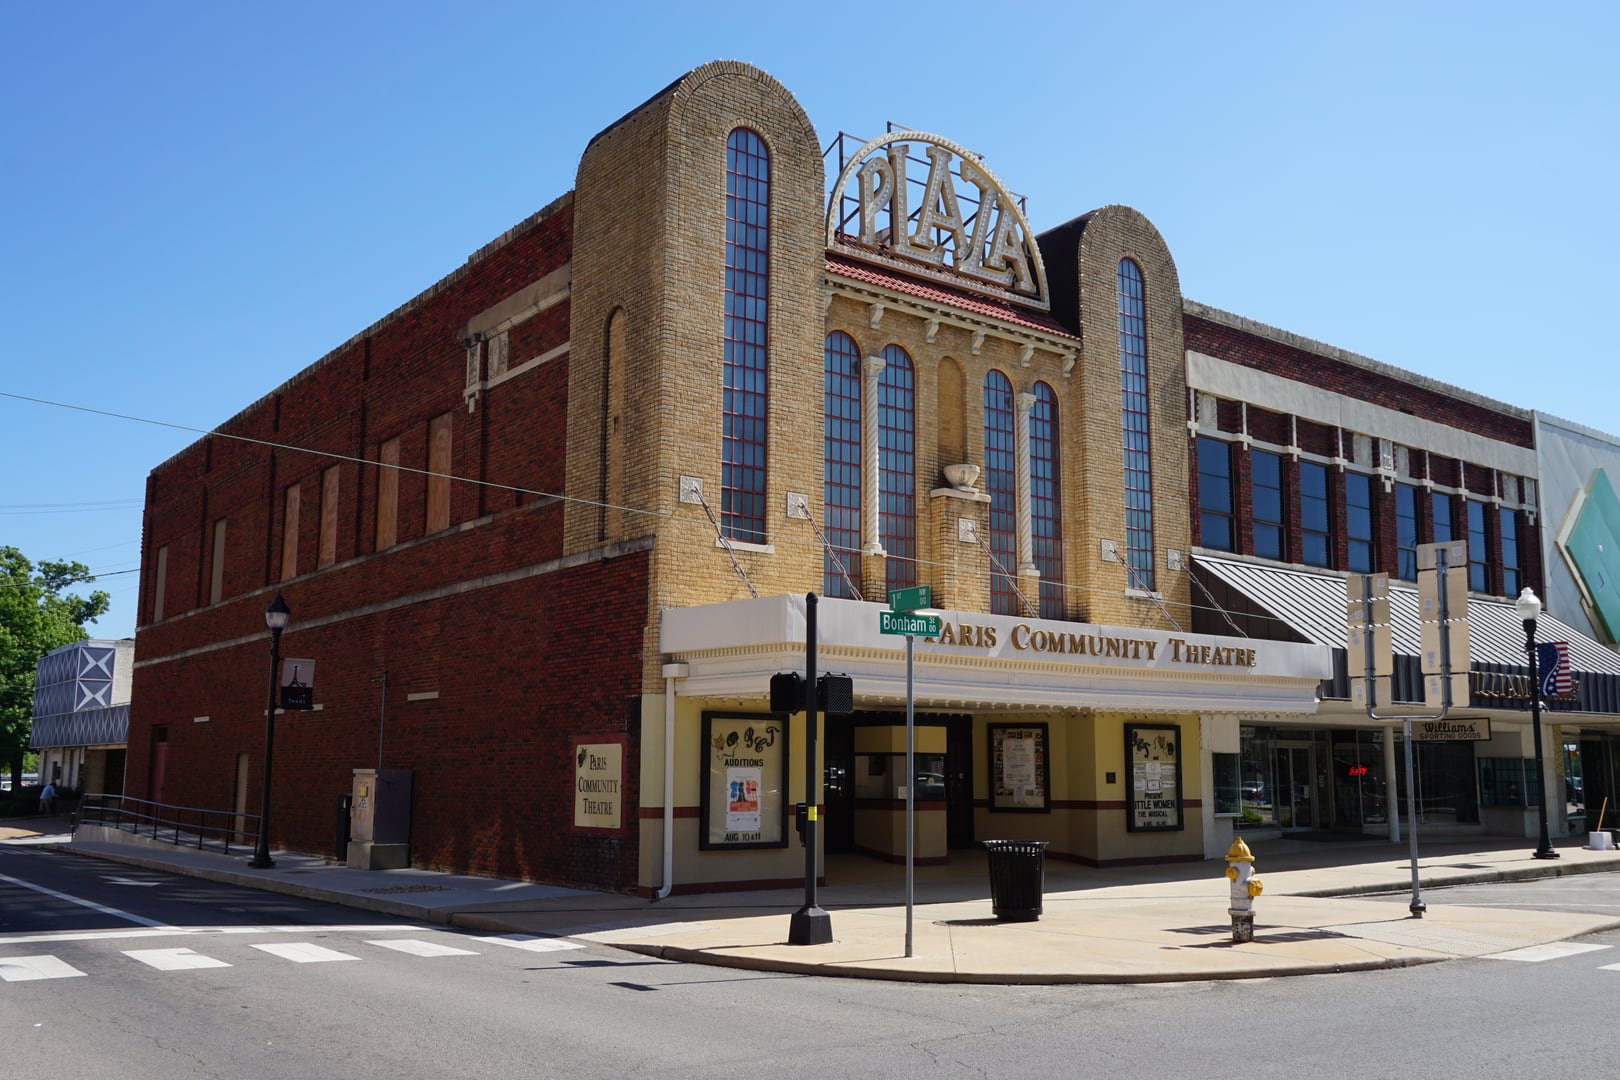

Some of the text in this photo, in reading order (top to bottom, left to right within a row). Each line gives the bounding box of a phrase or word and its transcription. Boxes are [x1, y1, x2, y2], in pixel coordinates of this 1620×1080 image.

[856, 144, 1036, 295] PLAZA
[883, 614, 926, 632] Bonham
[929, 625, 937, 633] 00
[1010, 623, 1158, 660] COMMUNITY
[1168, 636, 1257, 668] THEATRE
[1419, 732, 1456, 740] SPORTING
[589, 754, 607, 770] PARIS
[725, 758, 764, 767] AUDITIONS
[578, 777, 618, 793] COMMUNITY
[583, 798, 613, 815] THEATRE
[1153, 800, 1176, 809] WOMEN
[1148, 810, 1169, 818] MUSICAL
[725, 833, 739, 841] AUG
[742, 833, 750, 841] 10
